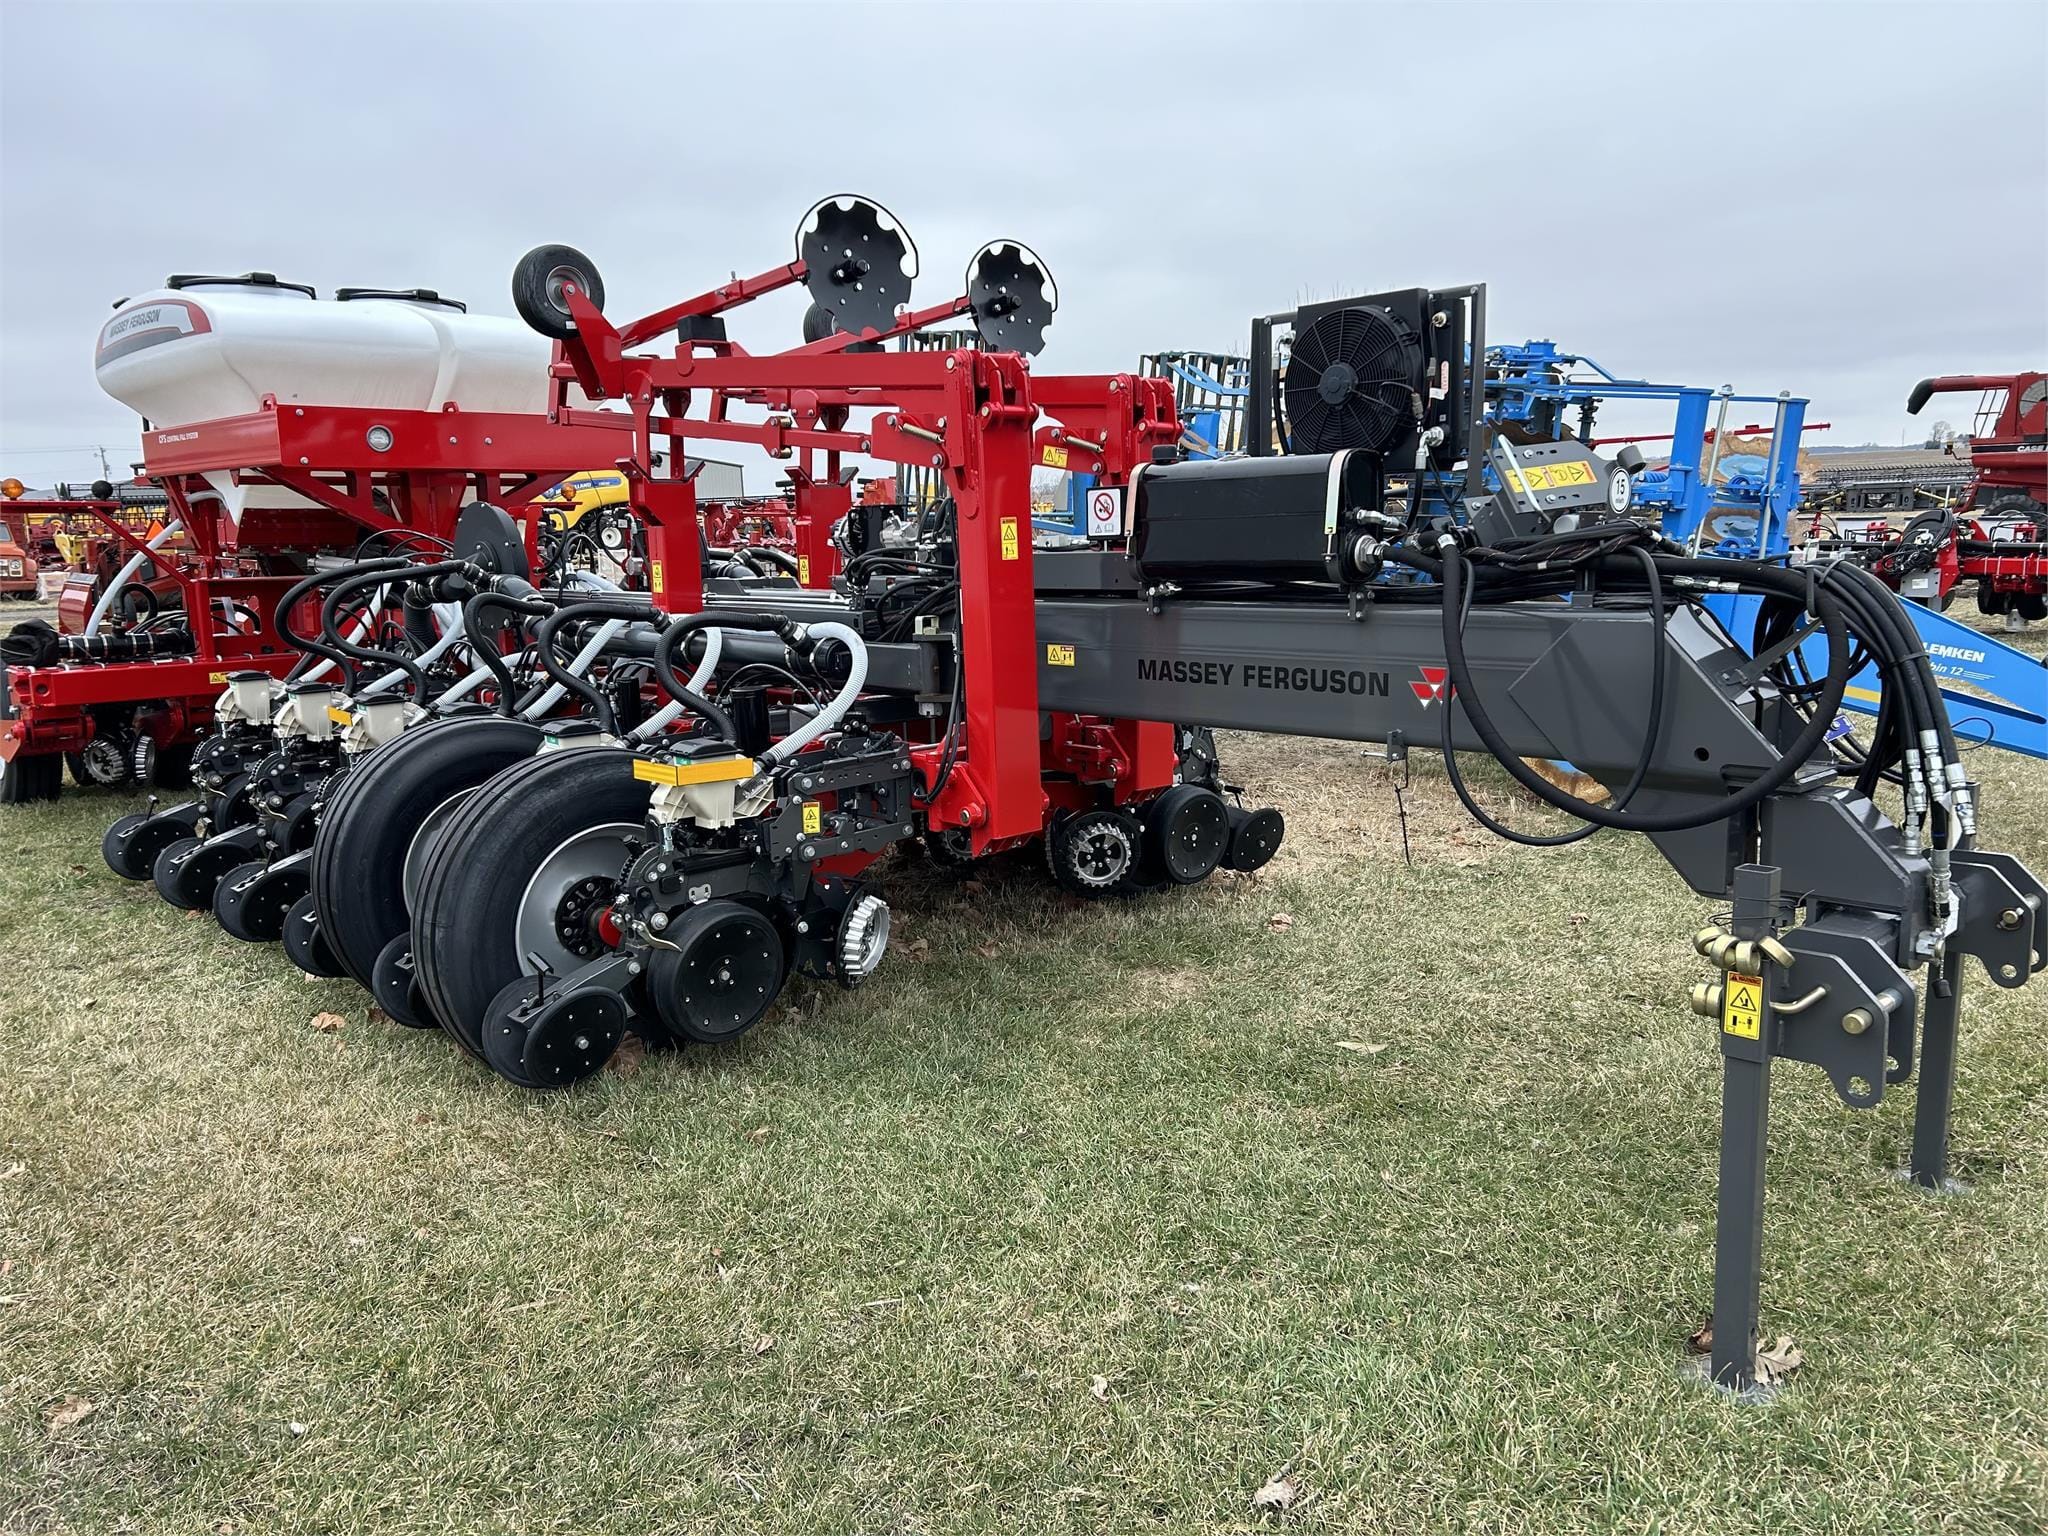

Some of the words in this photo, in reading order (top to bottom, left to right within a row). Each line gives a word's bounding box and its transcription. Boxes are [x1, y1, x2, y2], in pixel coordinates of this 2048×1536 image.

[129, 309, 161, 329] FERGUSON
[1616, 479, 1625, 495] 15
[1923, 642, 1986, 663] LEMKEN
[1137, 659, 1234, 686] MASSEY
[1243, 664, 1390, 697] FERGUSON
[1930, 662, 1948, 673] bin
[1950, 666, 1963, 676] 12
